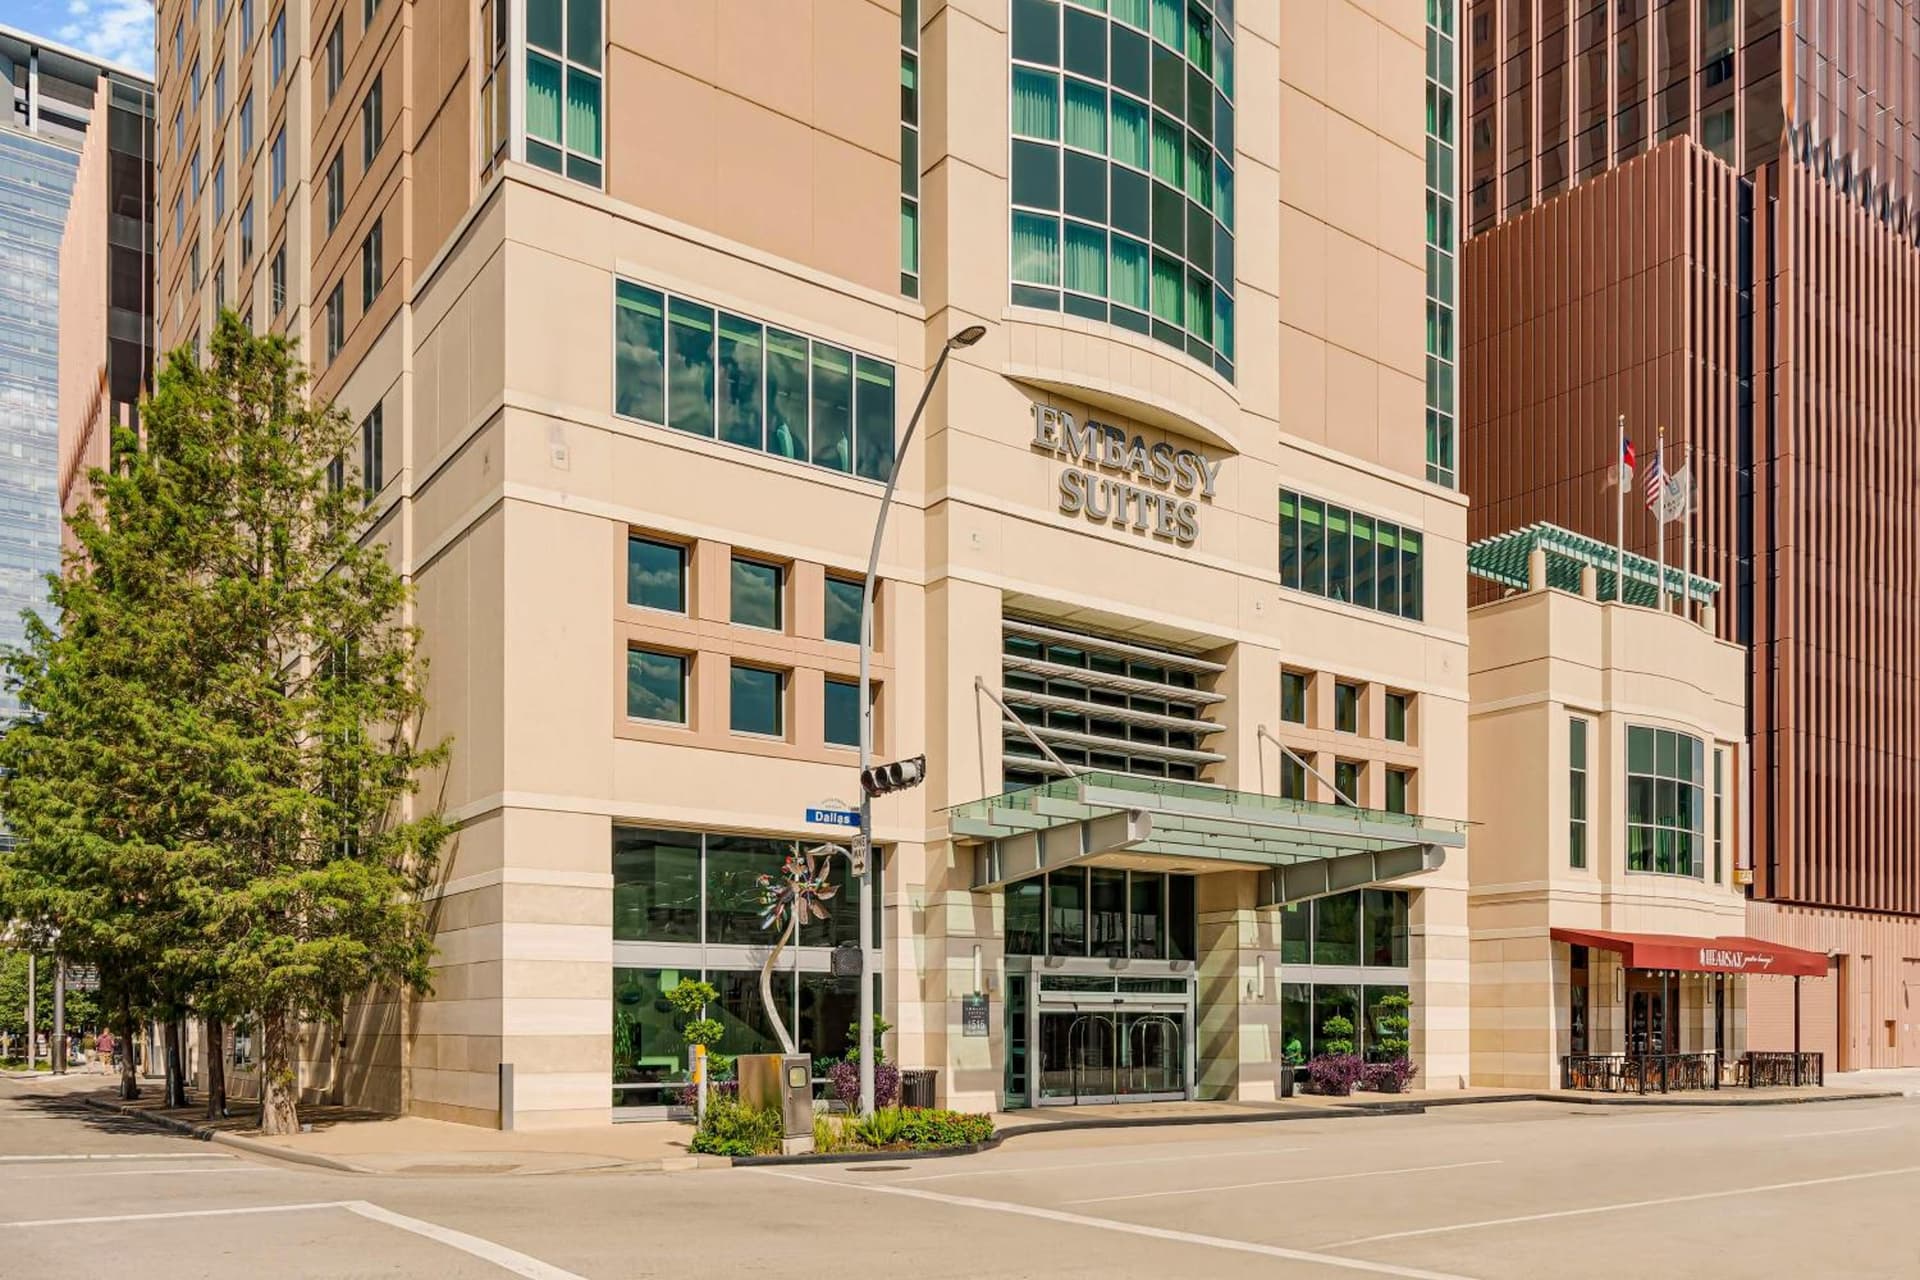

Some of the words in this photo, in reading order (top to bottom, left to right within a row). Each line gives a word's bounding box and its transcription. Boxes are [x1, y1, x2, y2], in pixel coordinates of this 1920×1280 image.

[1031, 402, 1222, 498] EMBASSY
[1059, 468, 1199, 543] SUITES
[815, 811, 850, 824] Dallas
